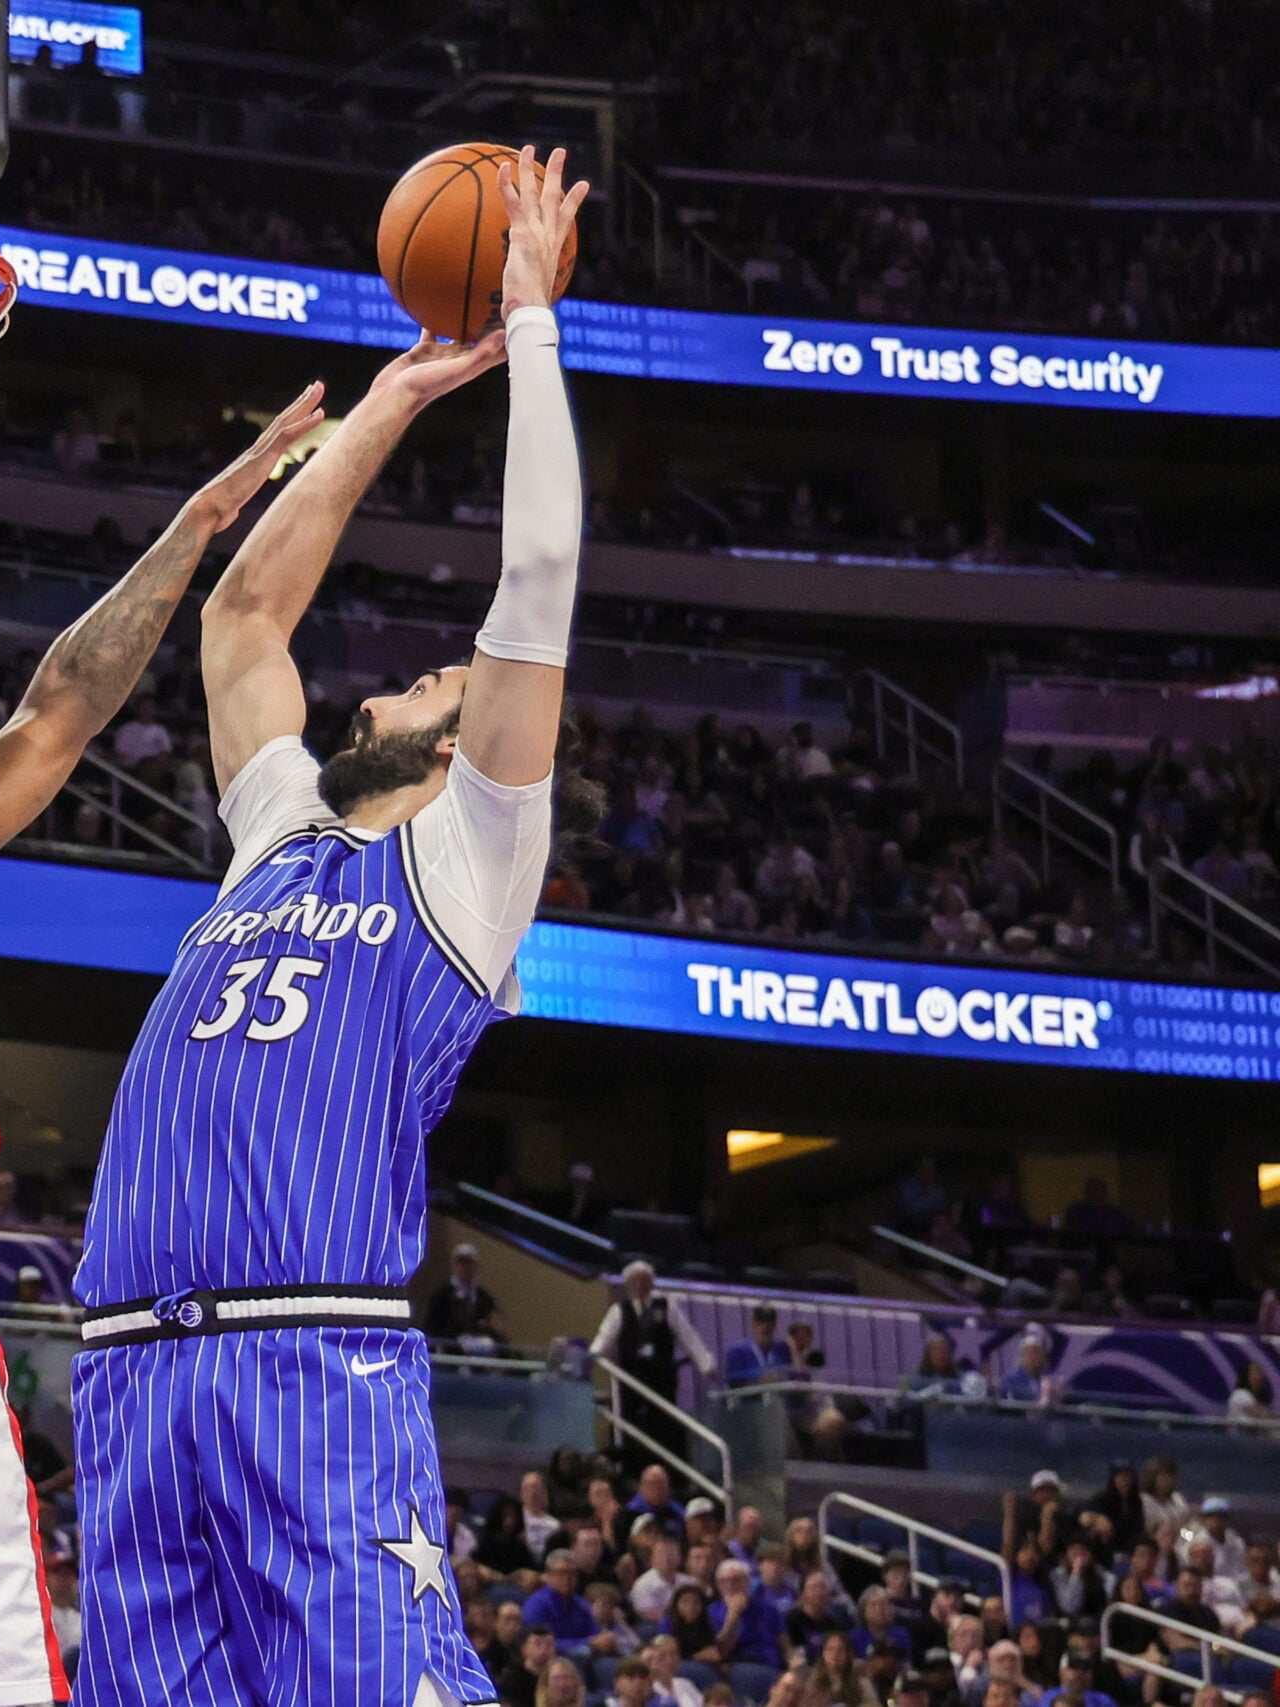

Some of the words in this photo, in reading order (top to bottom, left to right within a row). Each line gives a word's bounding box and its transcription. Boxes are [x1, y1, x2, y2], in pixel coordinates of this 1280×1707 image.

[763, 330, 863, 376] Zero
[871, 337, 981, 384] Trust
[990, 345, 1164, 403] Security
[190, 956, 329, 1042] 35
